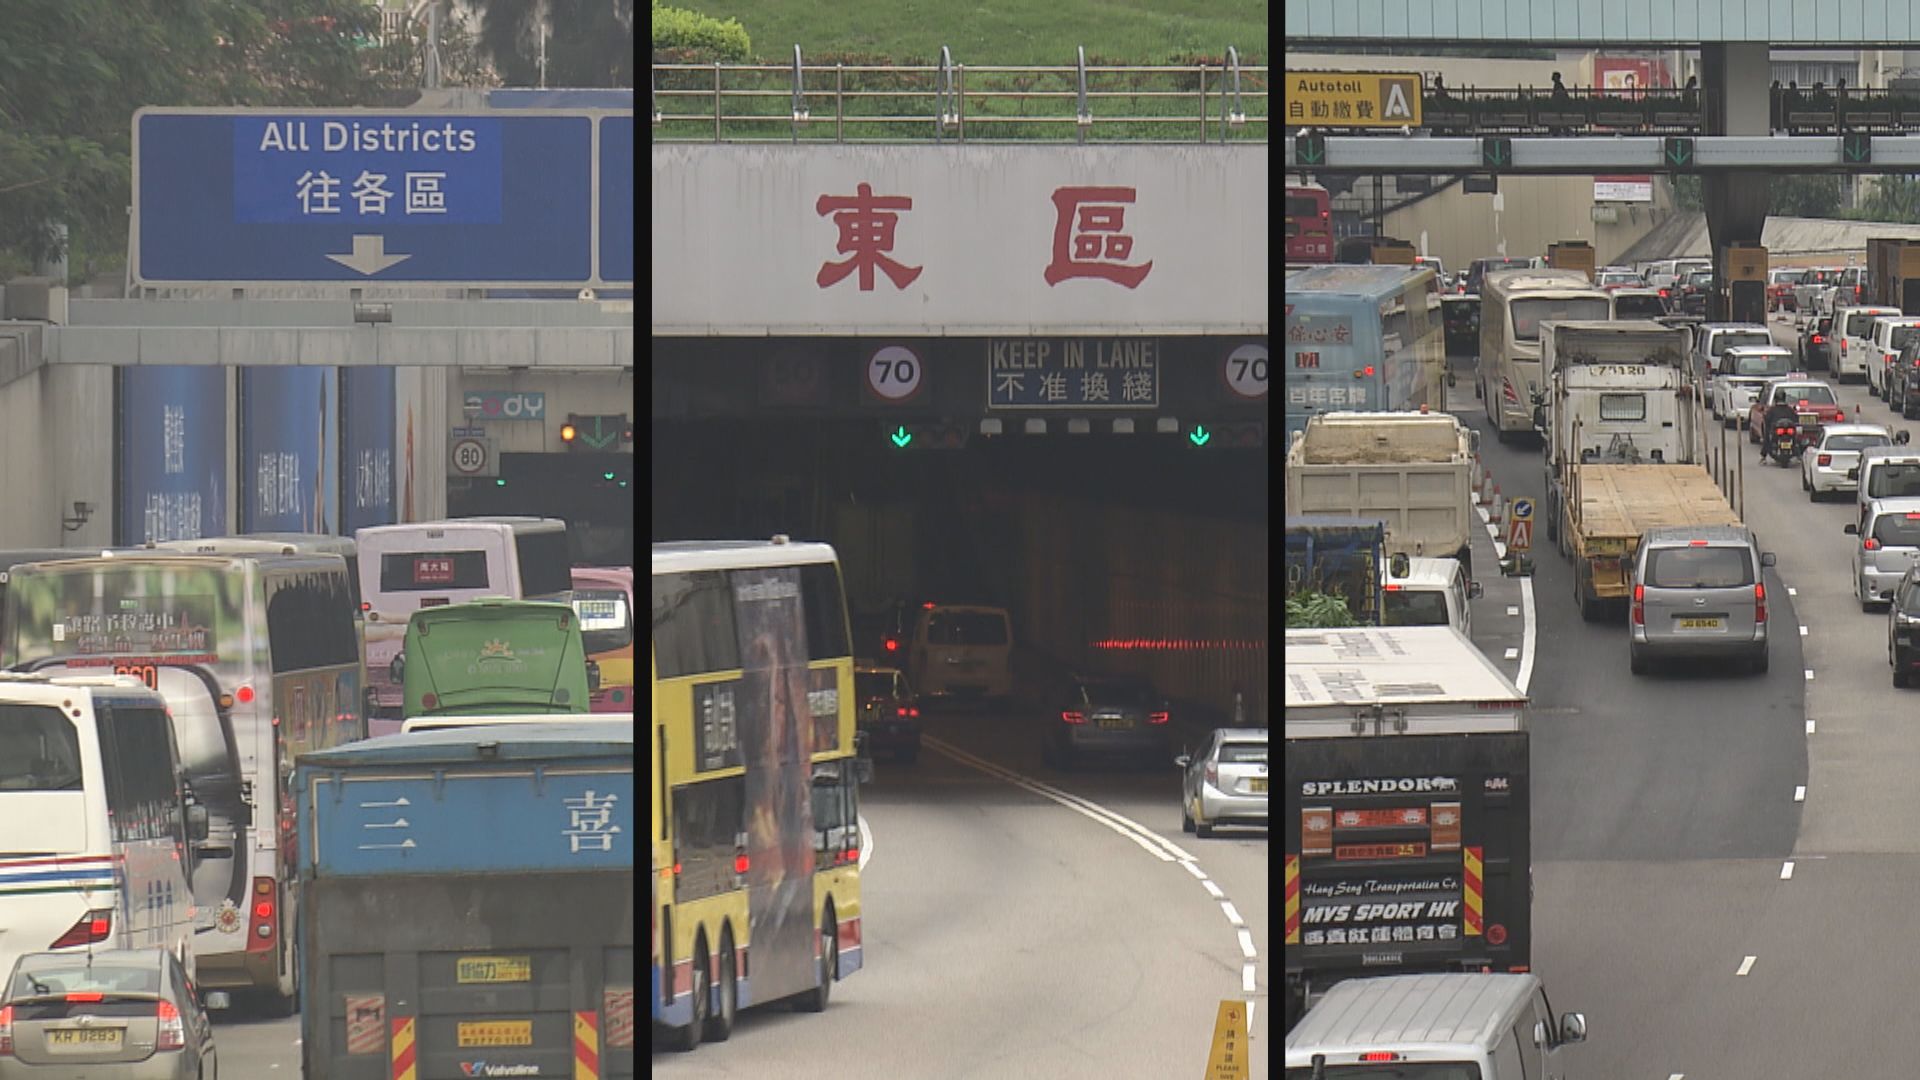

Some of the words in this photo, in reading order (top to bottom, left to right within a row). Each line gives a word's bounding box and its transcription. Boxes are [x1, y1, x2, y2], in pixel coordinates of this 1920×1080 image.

[1297, 80, 1361, 92] Autotoll
[1289, 100, 1374, 118] 自動繳費
[259, 122, 310, 151] All
[323, 121, 477, 151] Districts
[296, 169, 448, 215] 往各區
[815, 182, 1154, 291] 東區
[993, 340, 1051, 369] KEEP
[1063, 340, 1084, 368] IN
[1096, 339, 1154, 368] LANE
[874, 360, 914, 384] 70
[1231, 358, 1268, 381] 70
[460, 448, 480, 465] 80
[1302, 777, 1433, 796] SPLENDOR
[358, 790, 622, 853] 三喜
[1365, 879, 1440, 895] Transportation
[1303, 905, 1352, 923] MYS
[1354, 902, 1425, 920] SPORT
[1428, 900, 1459, 917] HK
